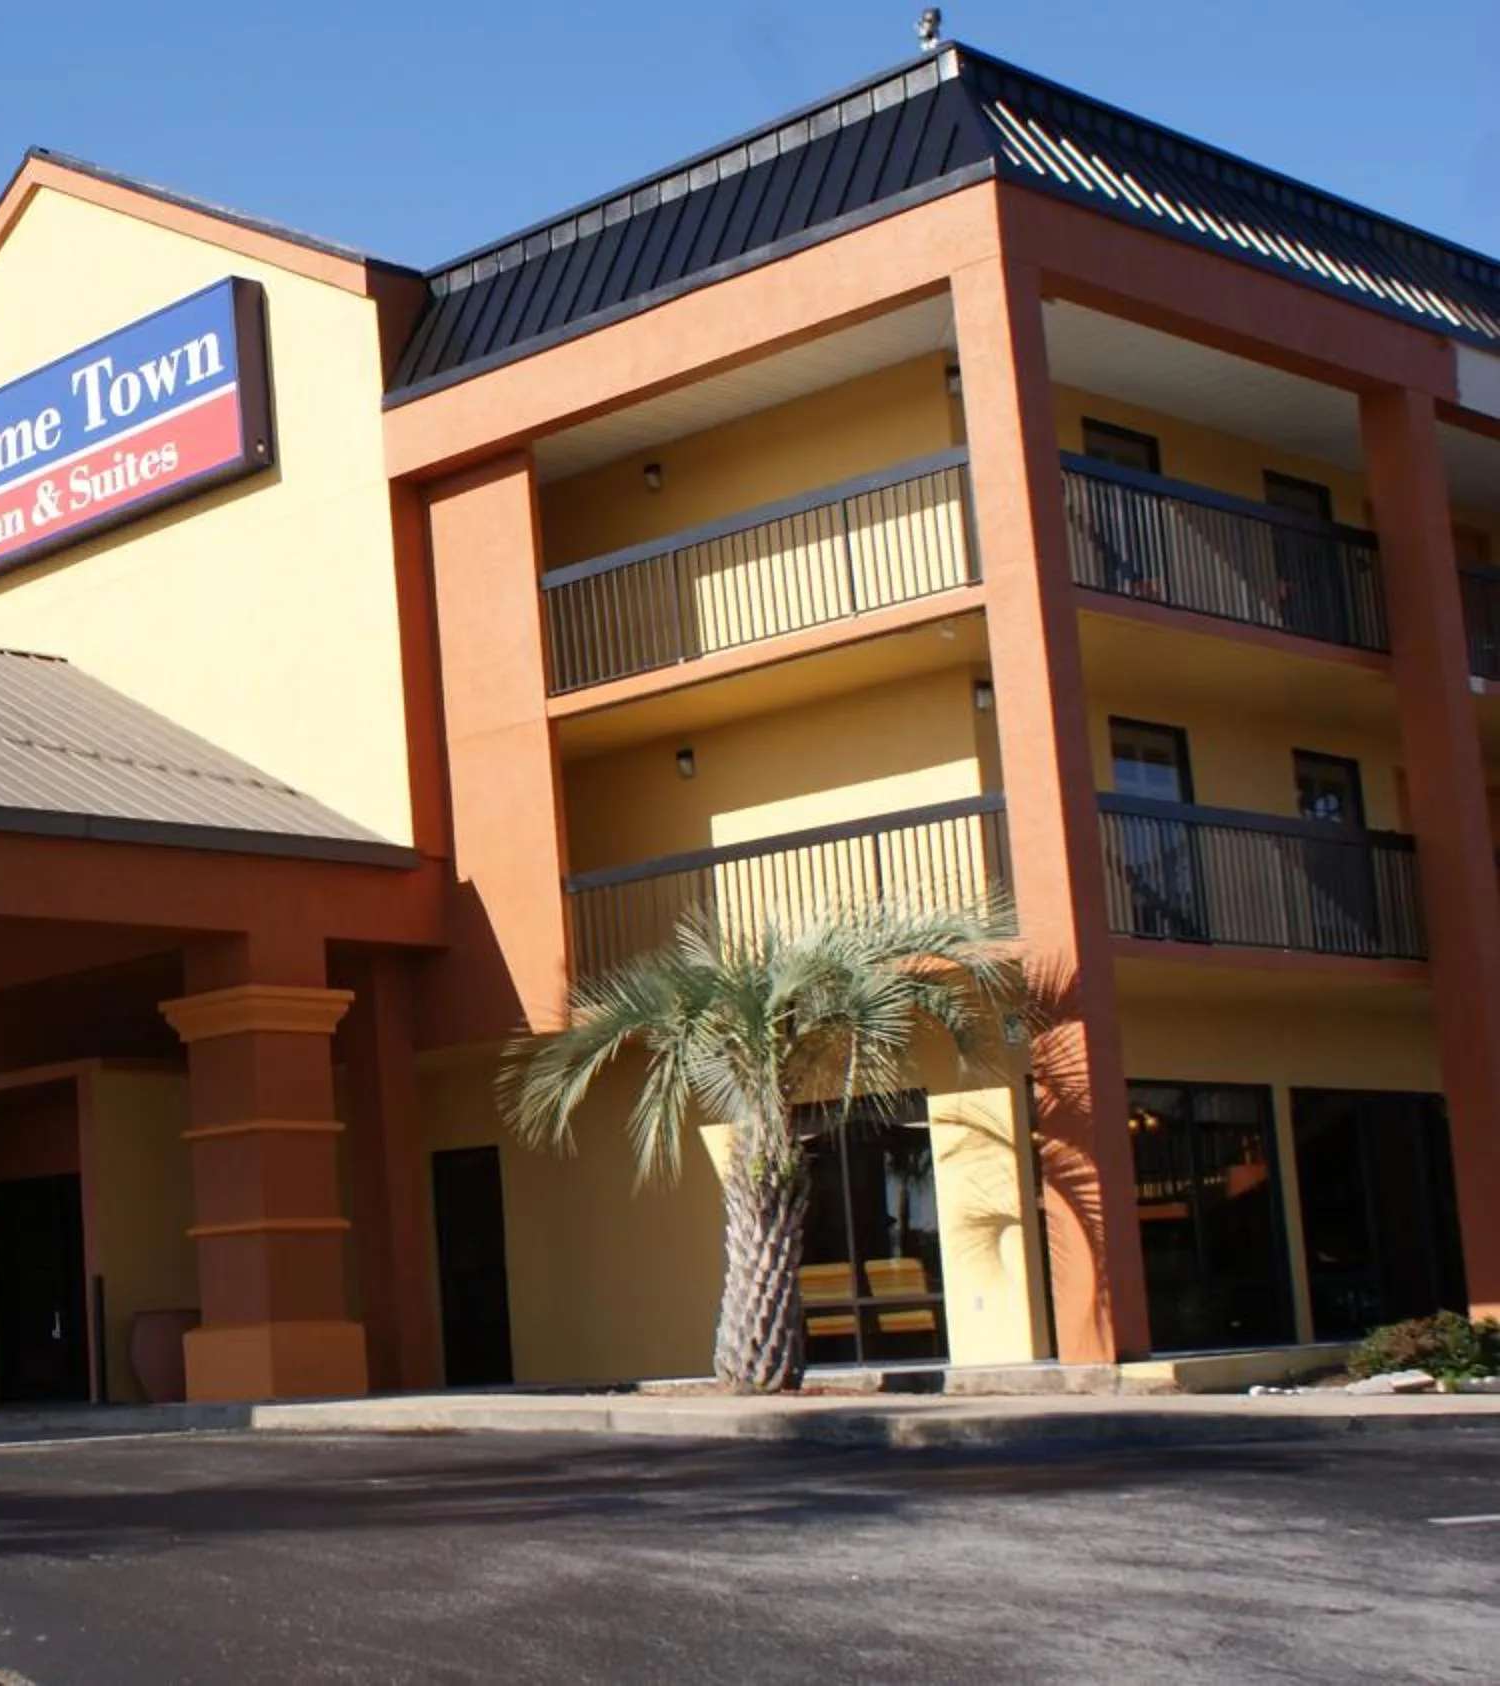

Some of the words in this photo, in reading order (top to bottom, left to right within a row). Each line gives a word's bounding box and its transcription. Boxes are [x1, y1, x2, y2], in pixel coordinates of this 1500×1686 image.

[71, 330, 225, 432] Town
[31, 479, 63, 527] &
[70, 440, 178, 510] Suites
